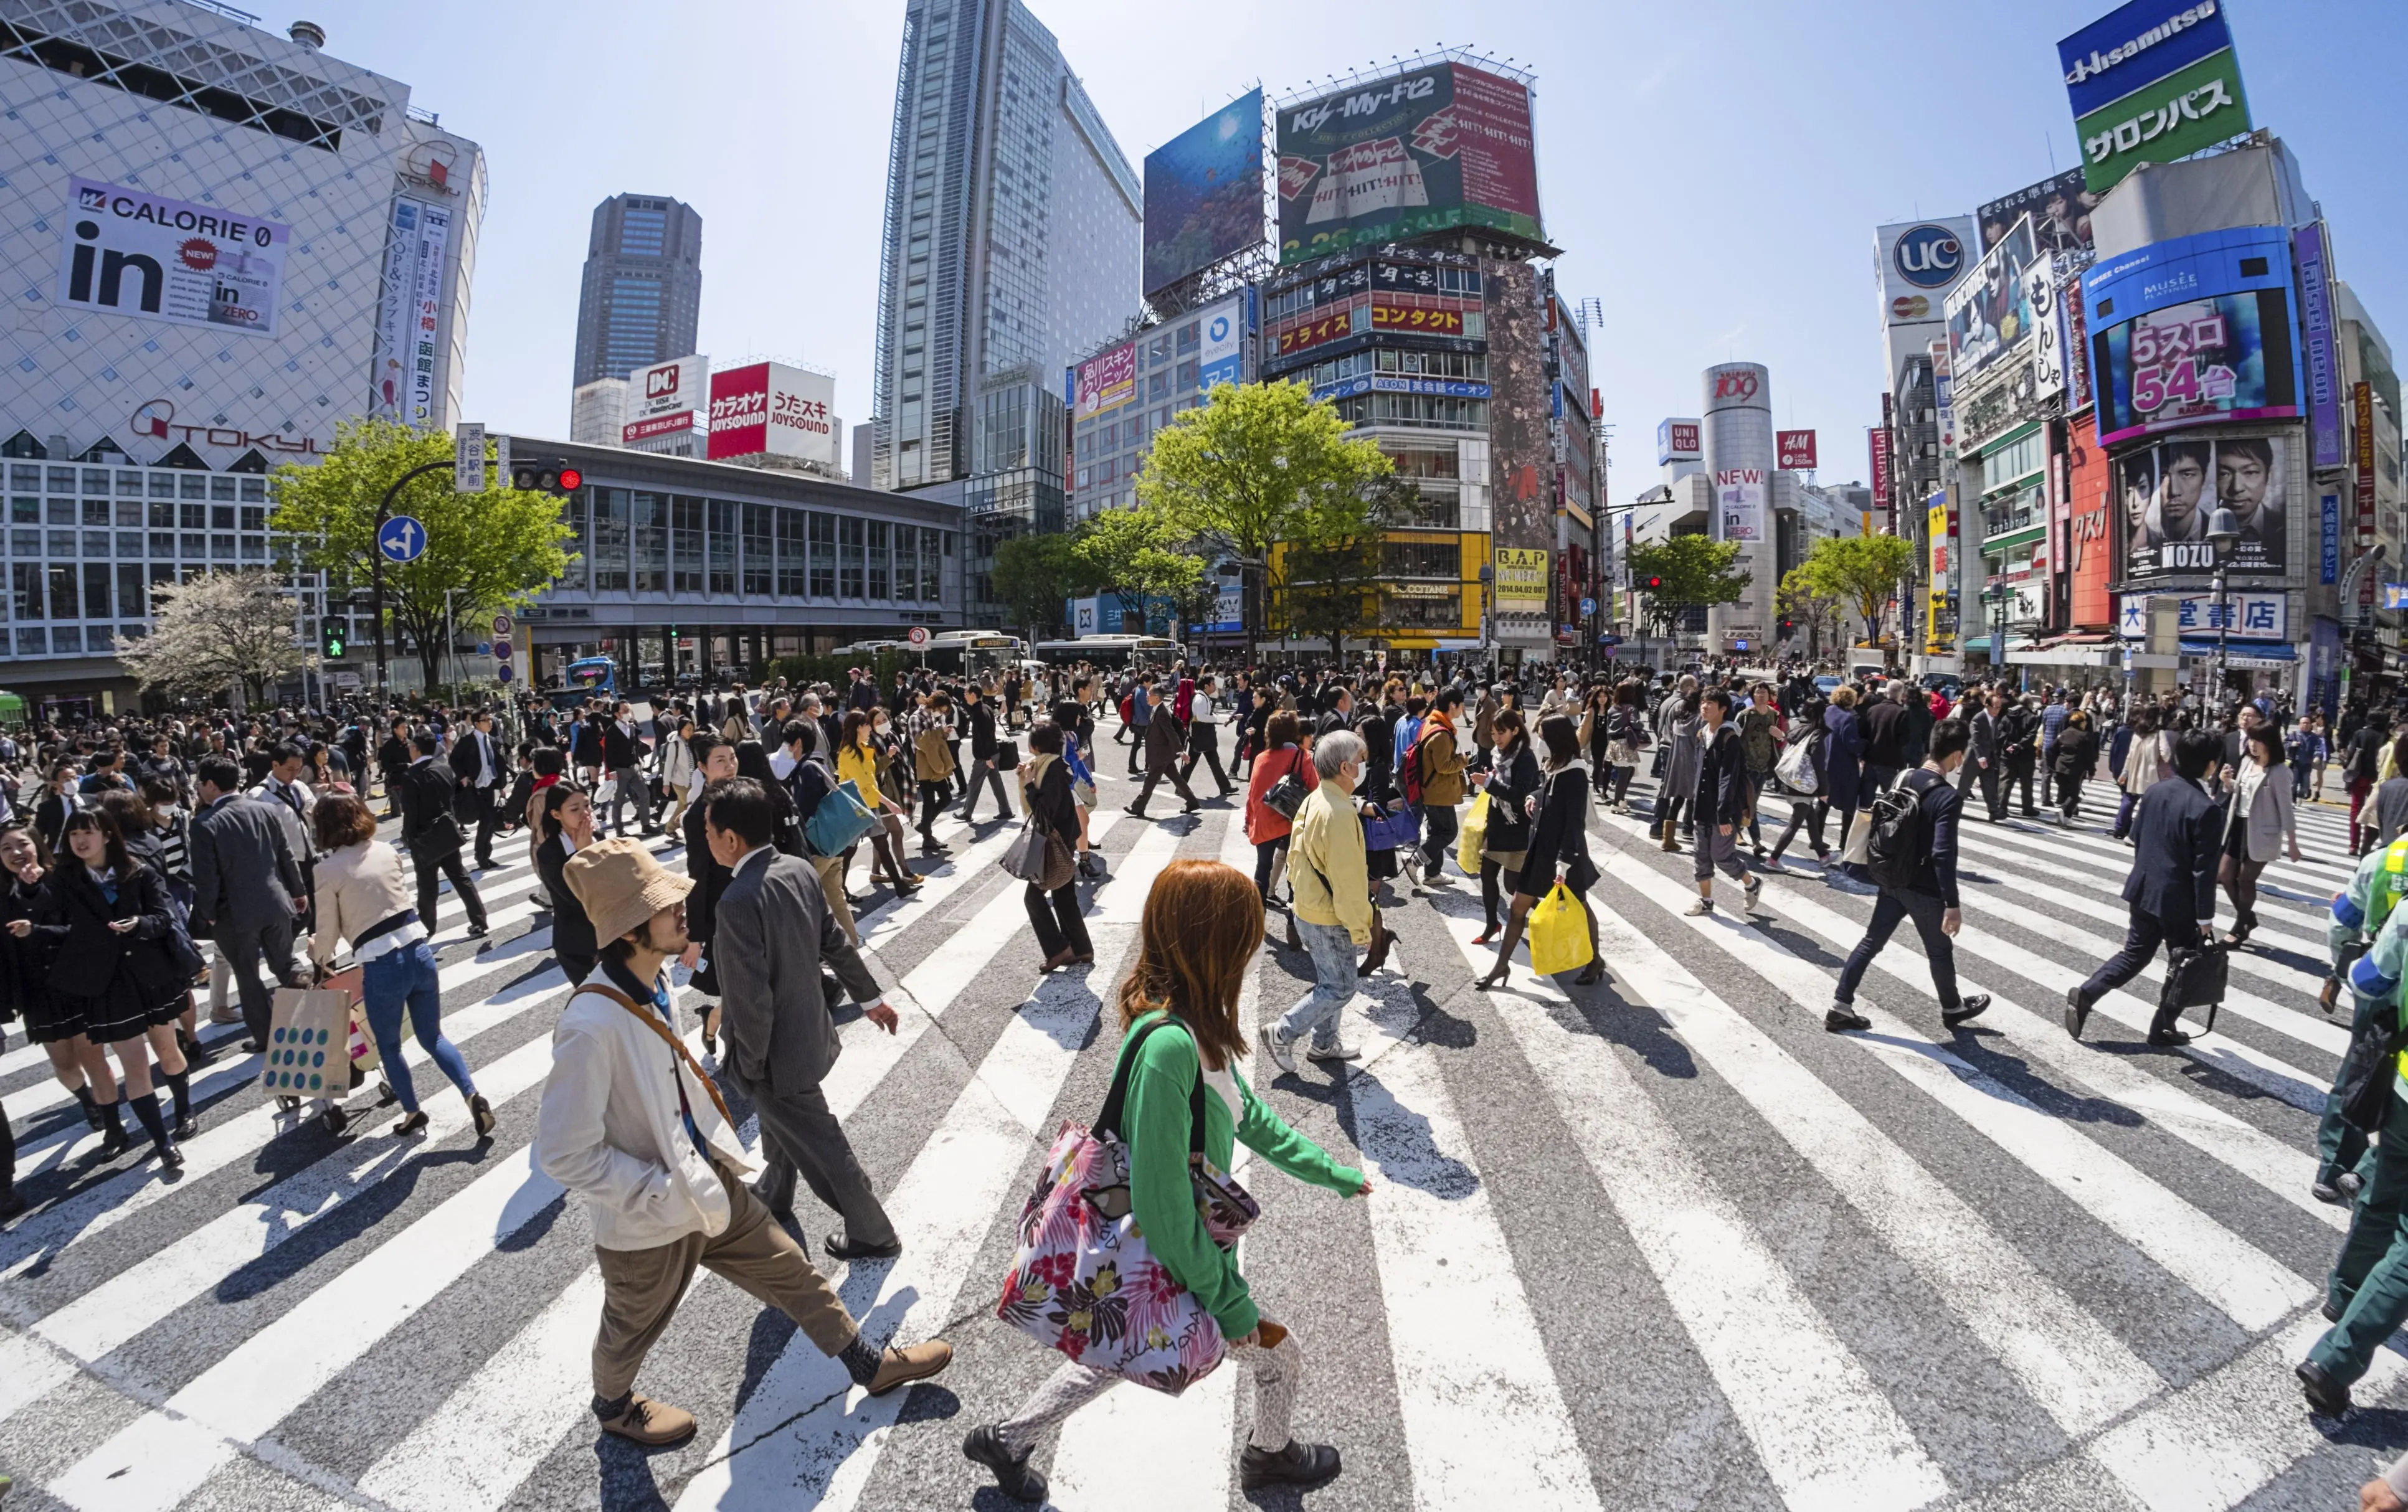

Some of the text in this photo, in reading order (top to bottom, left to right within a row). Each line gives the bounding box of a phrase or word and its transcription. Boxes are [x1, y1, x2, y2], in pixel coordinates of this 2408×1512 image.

[2065, 0, 2216, 84] Hisamitsu
[2085, 78, 2232, 163] サロンパス
[1458, 119, 1532, 149] HIT! HIT! HIT!
[1347, 178, 1383, 197] HIT!
[1383, 173, 1423, 187] HIT!
[112, 197, 272, 247] CALORIE 0
[69, 220, 163, 313] in
[186, 250, 214, 260] NEW!
[2114, 255, 2150, 274] Channel
[226, 274, 261, 286] CALORIE
[1380, 265, 1436, 288] 月の宴
[216, 281, 239, 304] in
[2302, 252, 2328, 333] Taisei
[222, 305, 258, 321] ZERO
[1372, 307, 1460, 329] コンタクト
[1281, 314, 1349, 349] プライス
[2031, 274, 2060, 387] もんじゃ
[2131, 316, 2226, 366] 5スロ
[1205, 341, 1235, 357] eyecity
[1084, 347, 1134, 381] 品川スキン
[1084, 363, 1134, 395] クリニック
[1376, 379, 1406, 390] AEON
[1412, 381, 1488, 395] 英会話イーオン
[1714, 376, 1759, 402] 109
[2132, 357, 2238, 413] 54台
[650, 401, 683, 414] MasterCard
[656, 396, 670, 406] VISA
[712, 391, 766, 418] カラオケ
[775, 390, 827, 420] うたスキ
[710, 411, 766, 433] JOYSOUND
[771, 412, 829, 435] JOYSOUND
[1675, 428, 1695, 437] UNI
[458, 438, 467, 465] Shibuya
[1676, 441, 1697, 450] QLO
[1784, 435, 1809, 450] H&M
[468, 428, 481, 487] 渋谷駅前
[1874, 429, 1887, 504] Essential
[1717, 470, 1764, 486] NEW!
[2359, 475, 2374, 527] 三千里
[1725, 512, 1740, 526] in
[1730, 526, 1753, 534] ZERO
[1987, 516, 2029, 536] Euphoria
[2323, 501, 2336, 579] 大盛堂商事ビル
[1497, 550, 1545, 565] B.A.P
[2162, 545, 2214, 568] MOZU
[1497, 584, 1546, 594] 2014.04.02 OUT
[2125, 601, 2276, 629] 大堂書店
